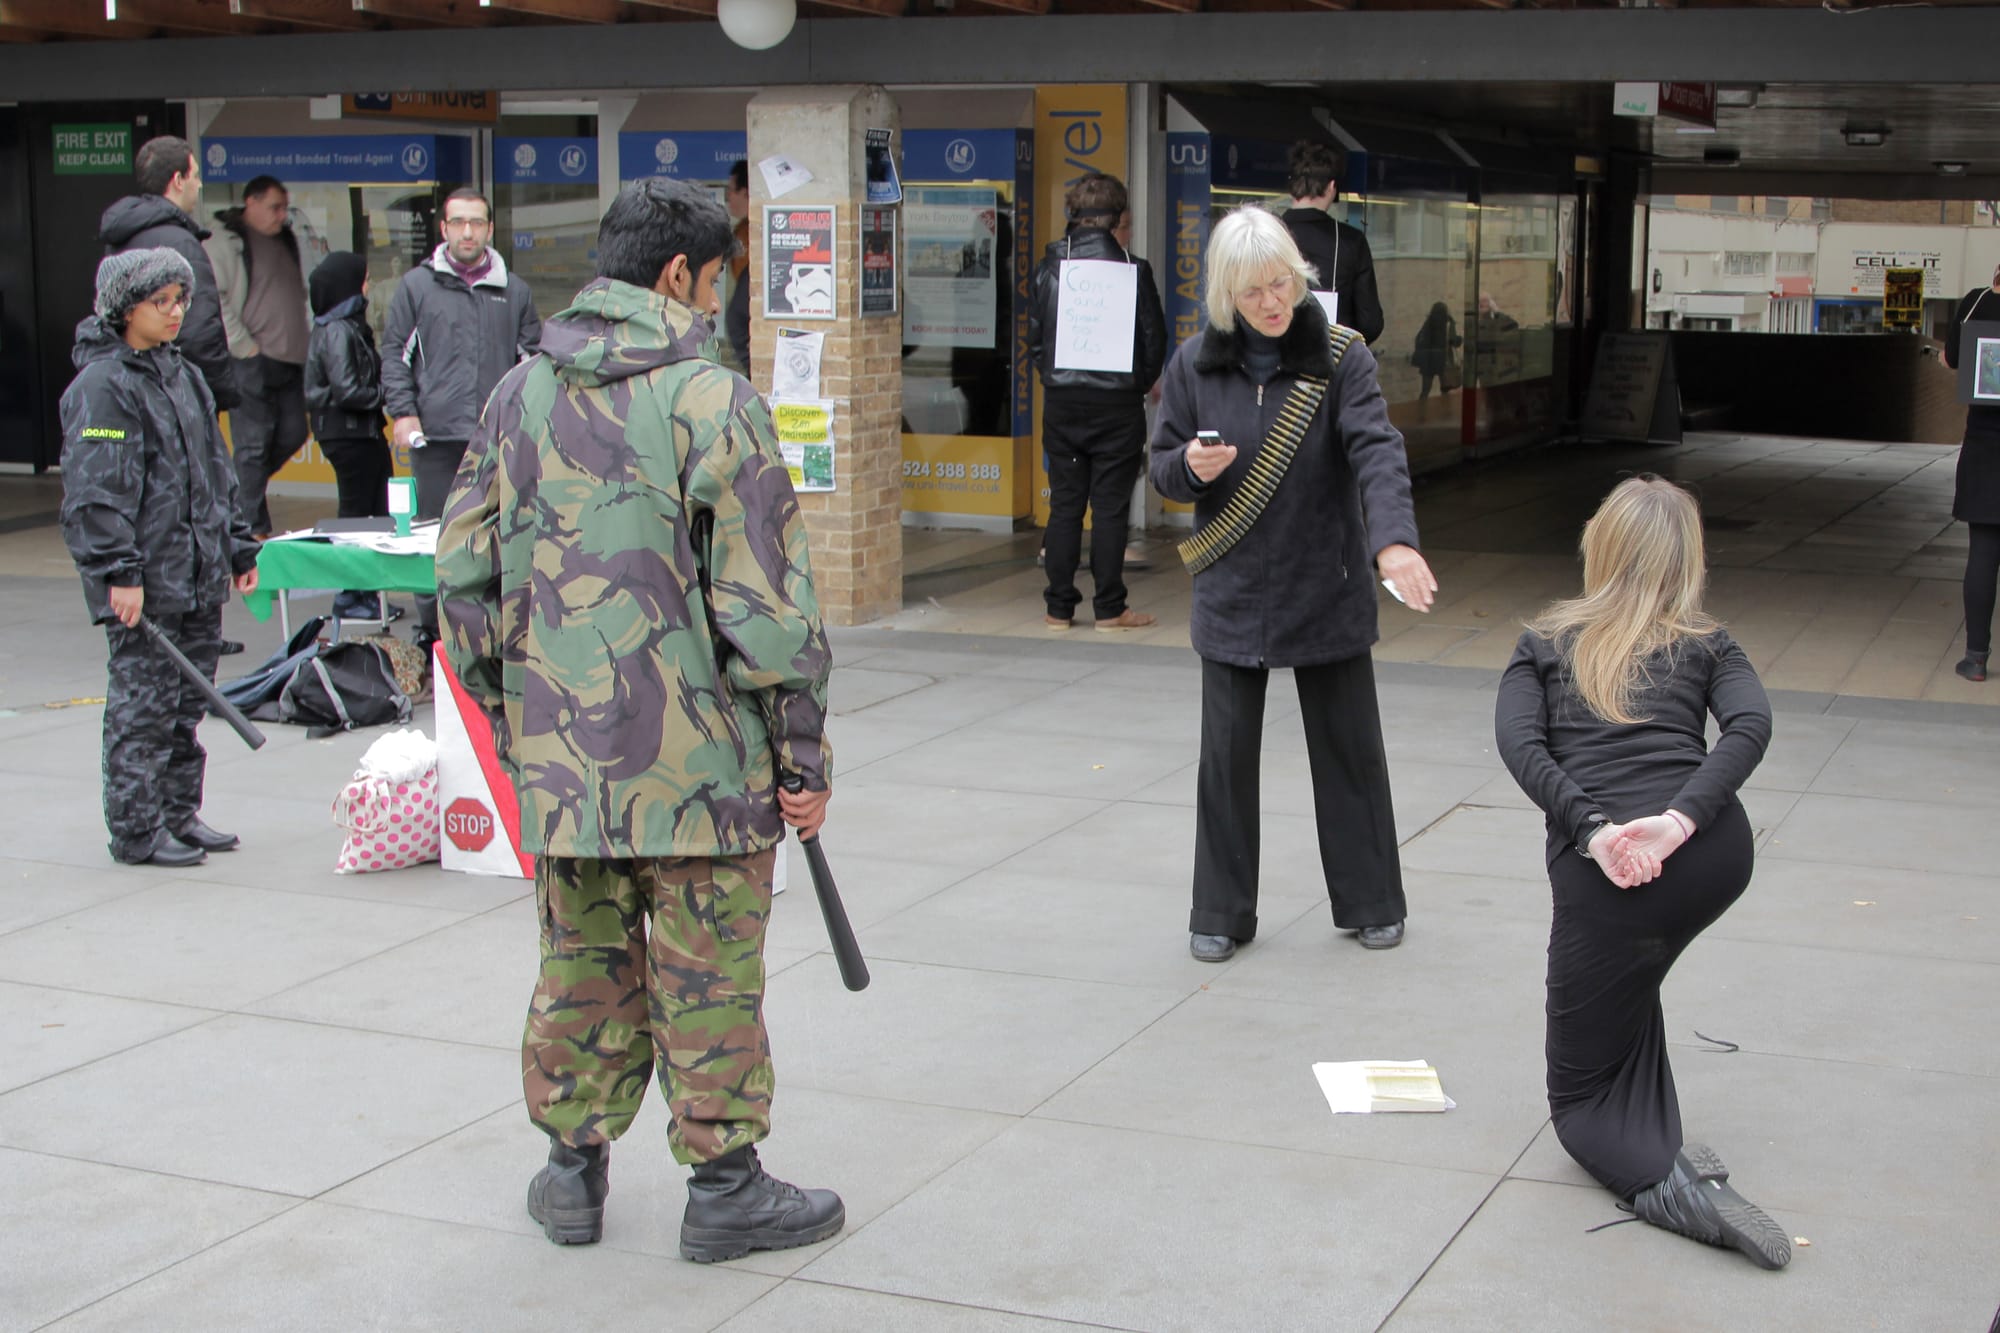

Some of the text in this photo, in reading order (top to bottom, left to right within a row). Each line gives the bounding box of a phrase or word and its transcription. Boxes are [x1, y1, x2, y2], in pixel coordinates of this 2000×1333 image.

[56, 132, 127, 149] FIRE EXIT
[59, 153, 125, 166] KEEP CLEAR
[231, 153, 393, 166] Licensed and Bonded Travel Agent
[655, 165, 679, 174] ABTA
[1017, 199, 1029, 299] AGENT
[1176, 200, 1201, 300] AGENT
[1855, 256, 1903, 267] CELL
[1923, 258, 1941, 268] IT
[1017, 307, 1029, 416] TRAVEL
[779, 407, 820, 417] Discover
[82, 428, 125, 439] LOCATION
[903, 461, 1001, 480] 524 388 388
[447, 812, 490, 836] STOP
